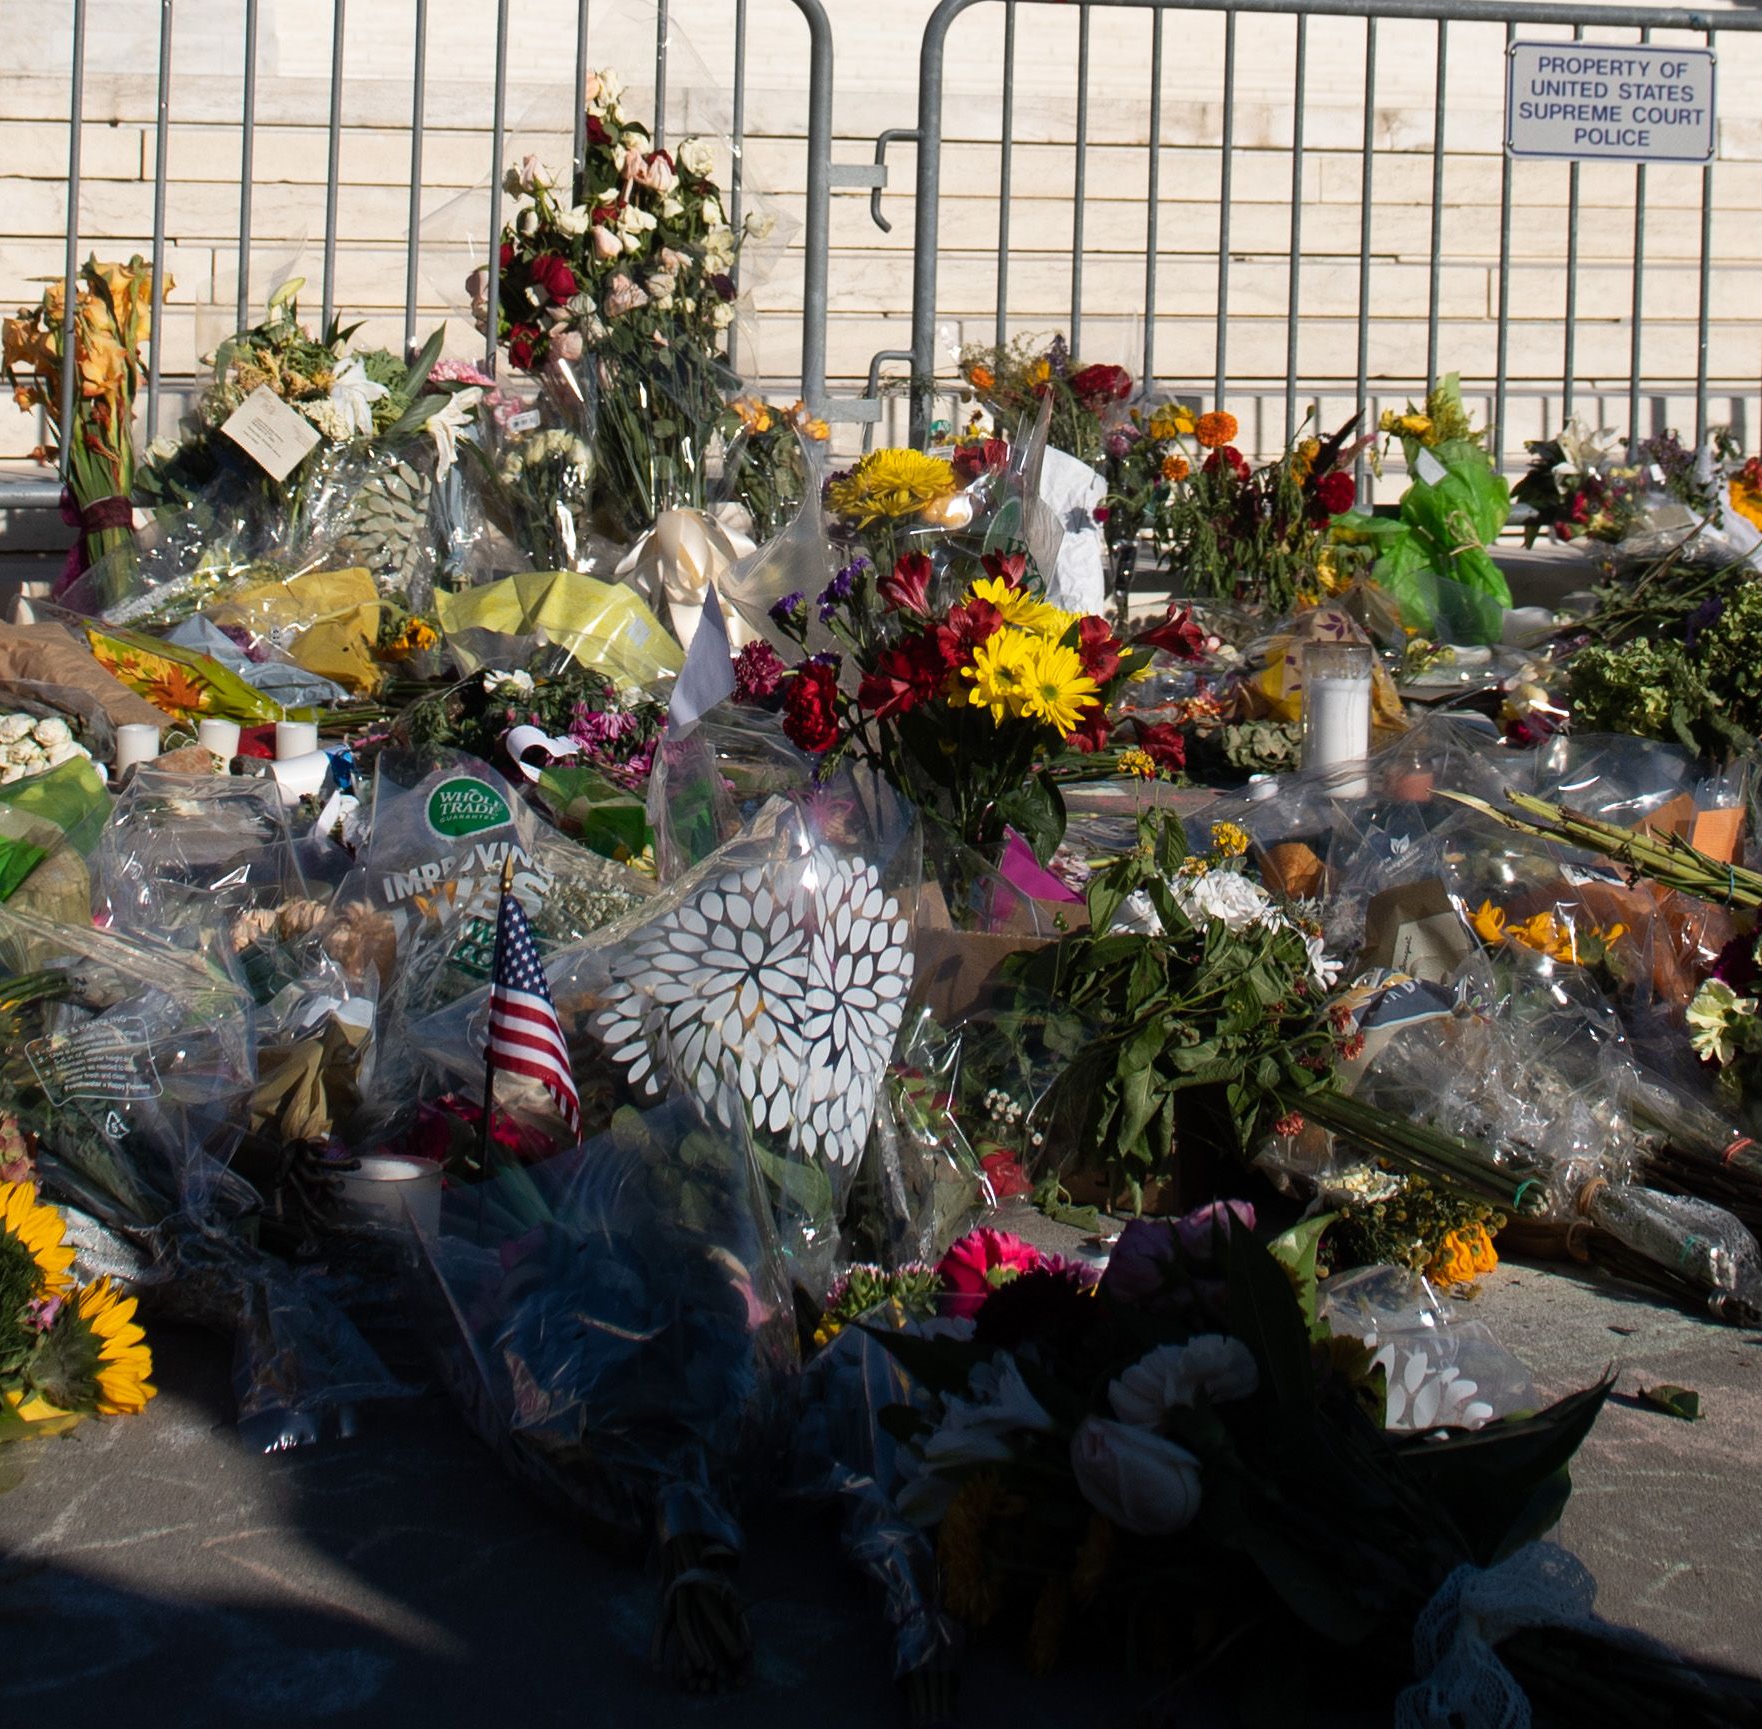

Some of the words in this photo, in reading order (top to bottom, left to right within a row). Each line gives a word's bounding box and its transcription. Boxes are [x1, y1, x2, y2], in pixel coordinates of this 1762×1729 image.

[1538, 56, 1651, 77] PROPERTY
[1660, 61, 1689, 79] OF
[1531, 79, 1609, 98] UNITED
[1618, 83, 1694, 102] STATES
[1519, 103, 1622, 122] SUPREME
[1632, 106, 1705, 125] COURT
[1574, 128, 1650, 147] POLICE
